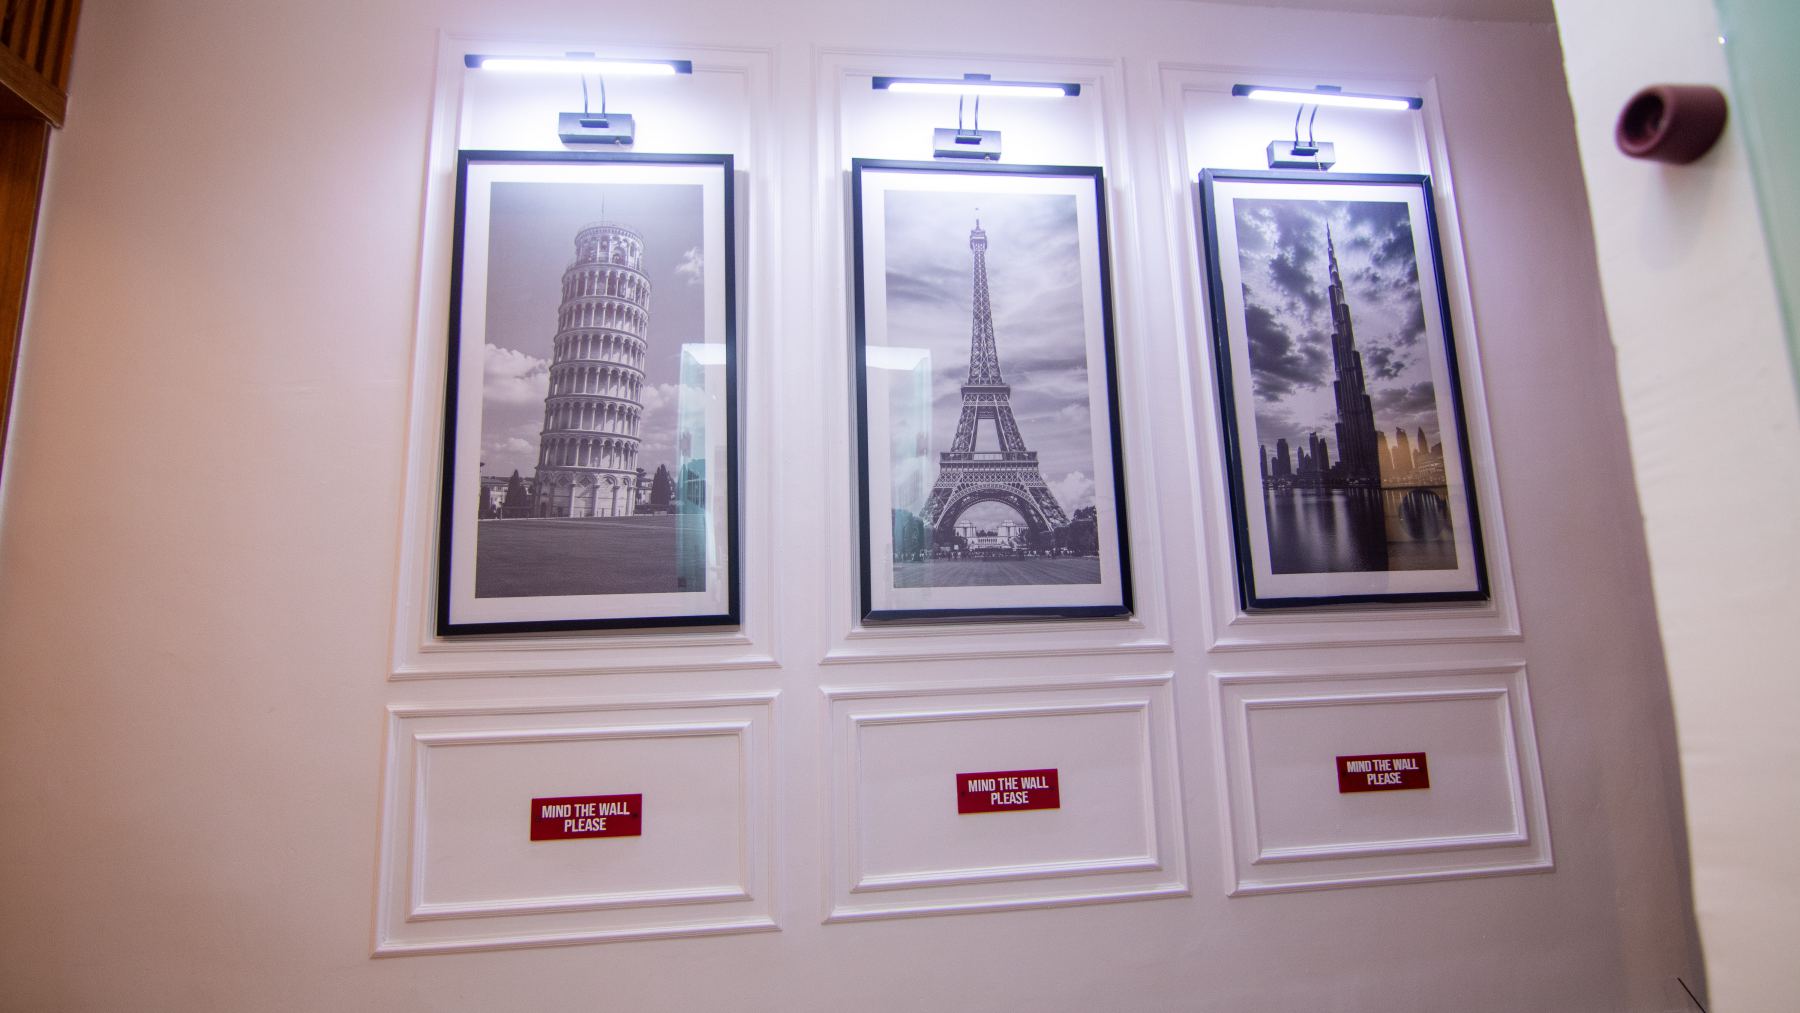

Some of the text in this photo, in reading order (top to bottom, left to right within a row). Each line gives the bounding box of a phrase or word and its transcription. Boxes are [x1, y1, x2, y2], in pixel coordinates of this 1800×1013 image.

[1347, 758, 1419, 773] MIND THE WALL
[968, 776, 1049, 792] MIND THE WALL
[1367, 772, 1402, 785] PLEASE
[991, 791, 1029, 805] PLEASE
[542, 802, 630, 818] MIND THE WALL
[564, 818, 607, 832] PLEASE
